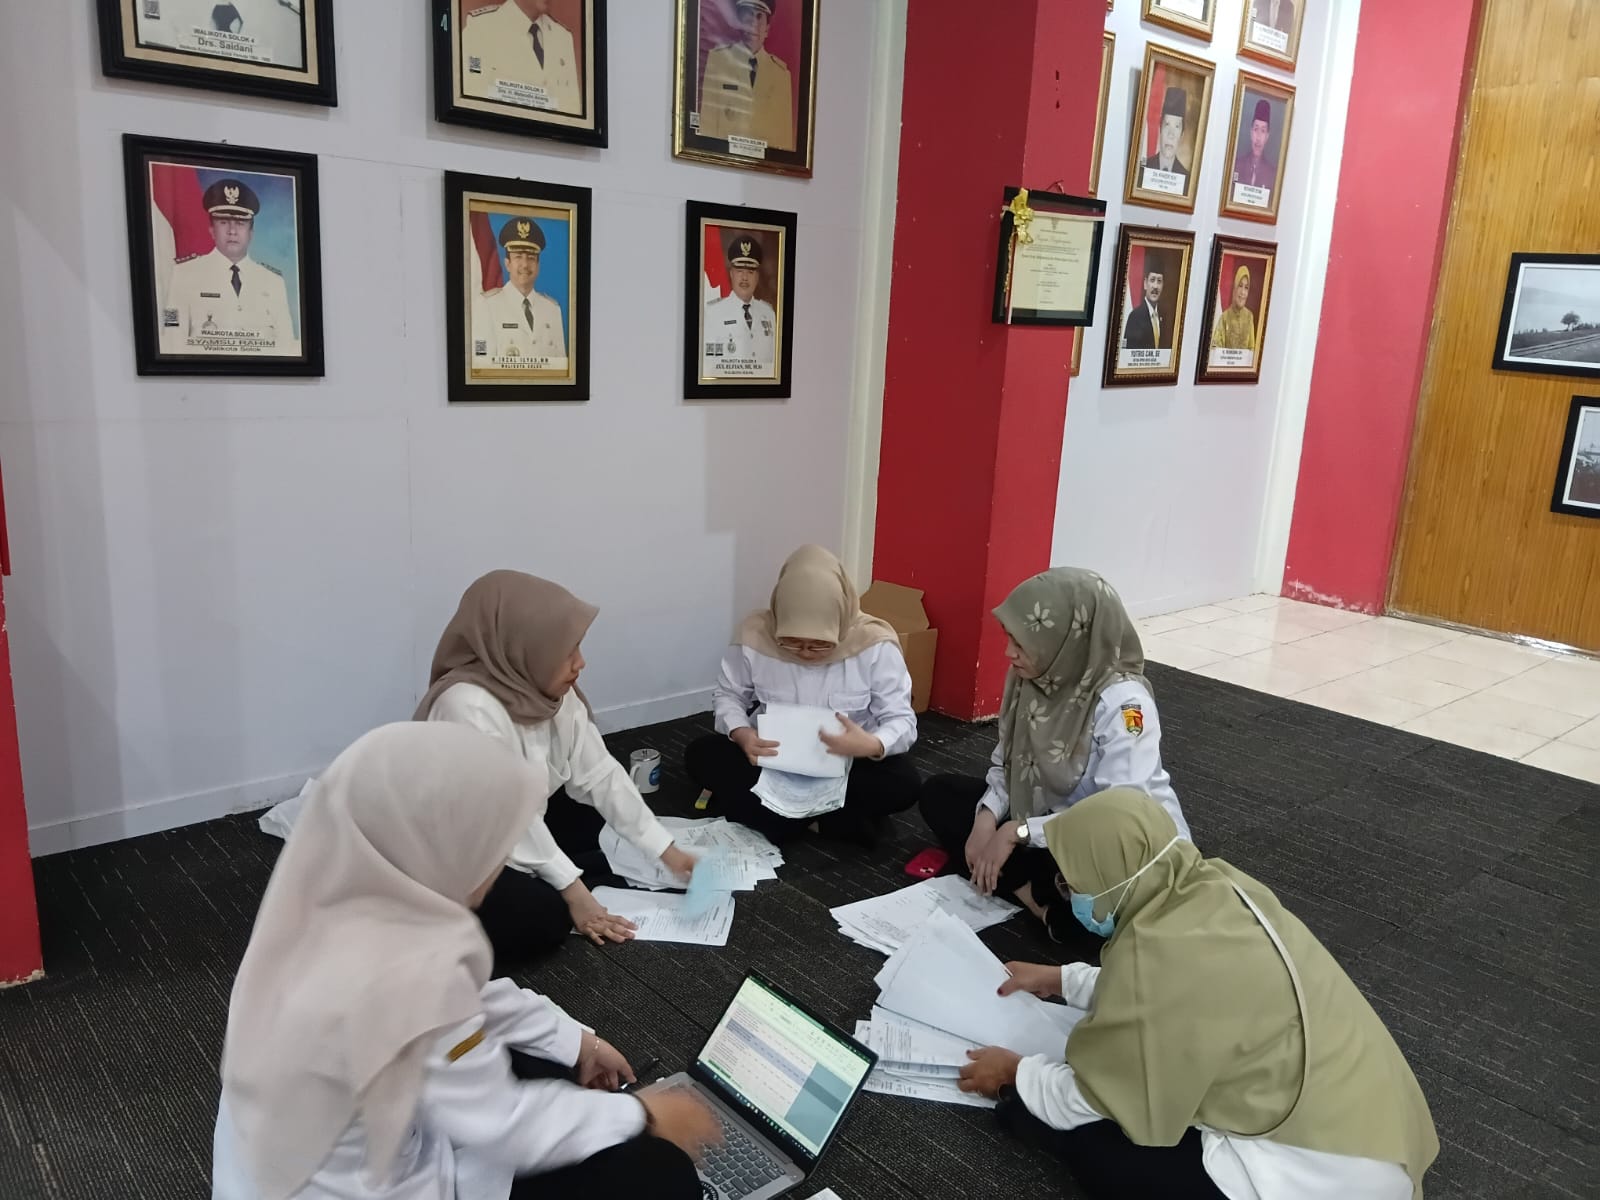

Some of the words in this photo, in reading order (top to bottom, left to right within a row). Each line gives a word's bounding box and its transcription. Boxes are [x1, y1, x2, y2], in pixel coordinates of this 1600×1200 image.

[193, 27, 227, 39] WALIKOTA
[228, 34, 250, 43] SOLOK
[198, 37, 217, 48] Drs.
